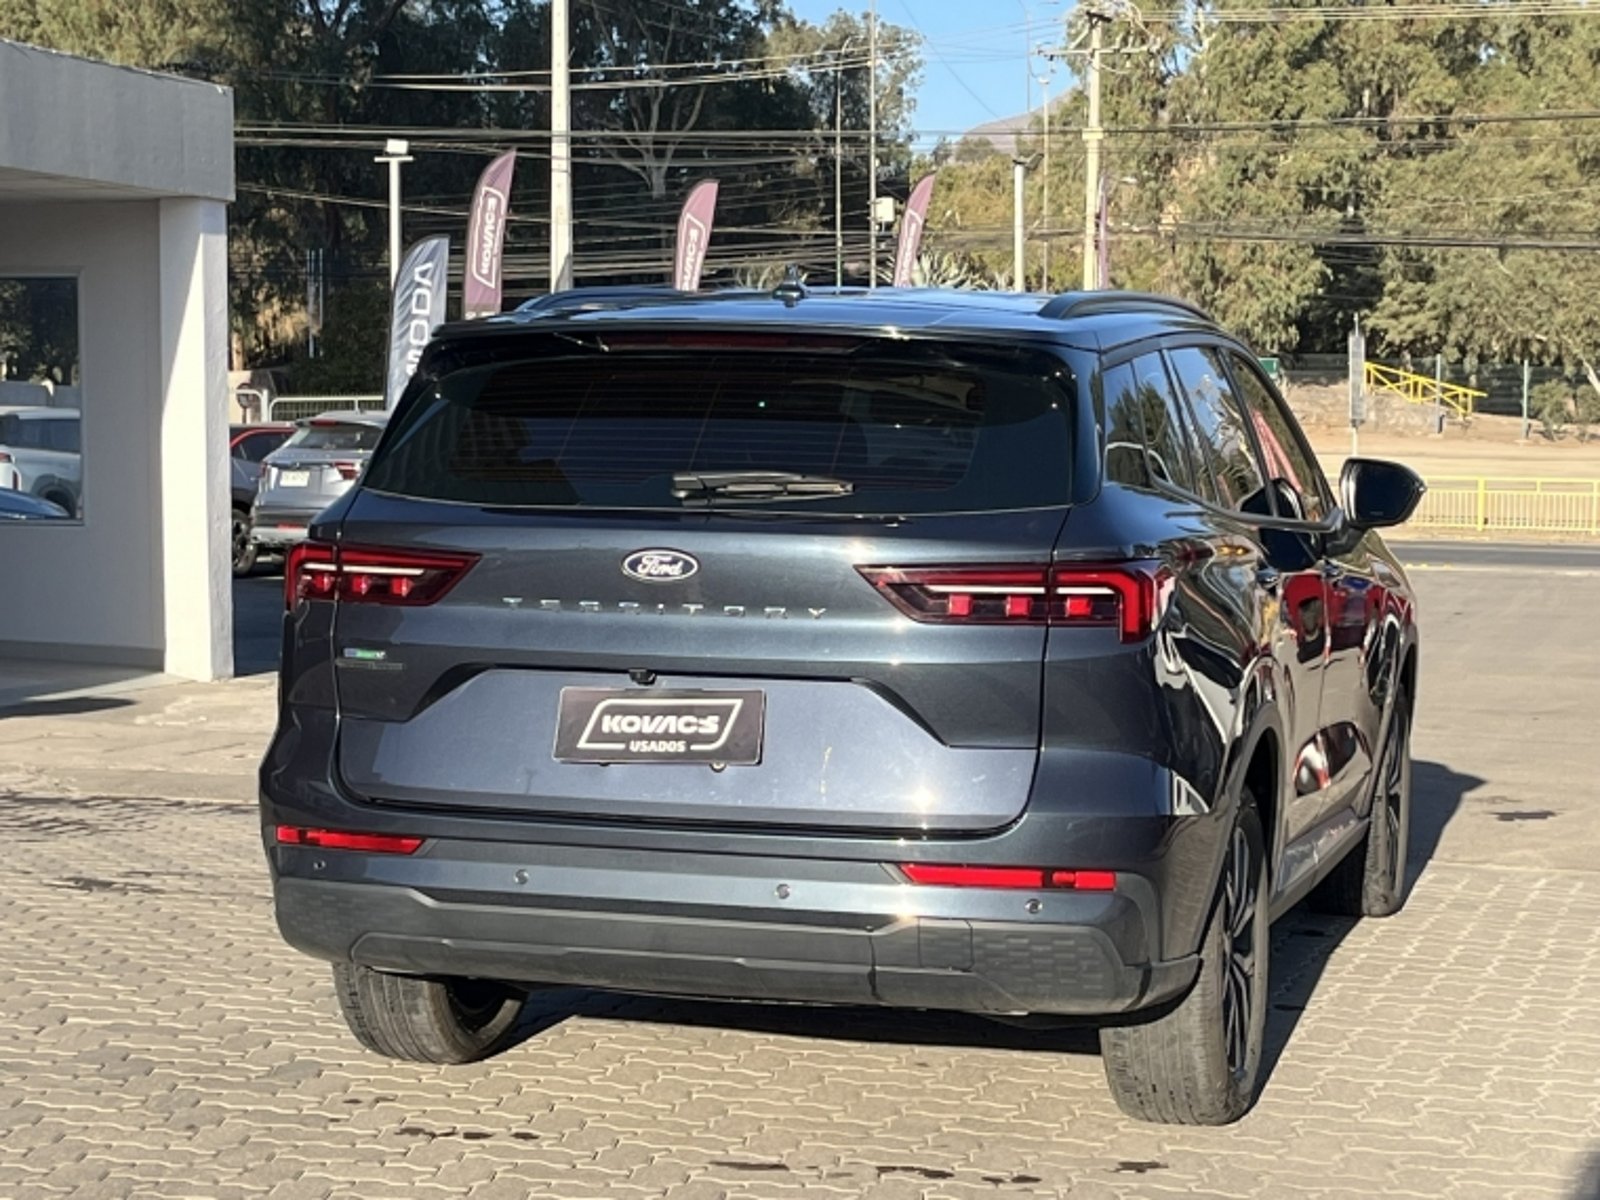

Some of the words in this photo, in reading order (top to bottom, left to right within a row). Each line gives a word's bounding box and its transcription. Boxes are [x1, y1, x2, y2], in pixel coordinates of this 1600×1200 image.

[481, 197, 496, 275] KOVACS
[406, 262, 433, 376] MODA
[637, 554, 685, 576] Ford
[502, 597, 827, 619] TERRITORY
[601, 715, 720, 734] KOVACS
[629, 740, 686, 753] USADOS
